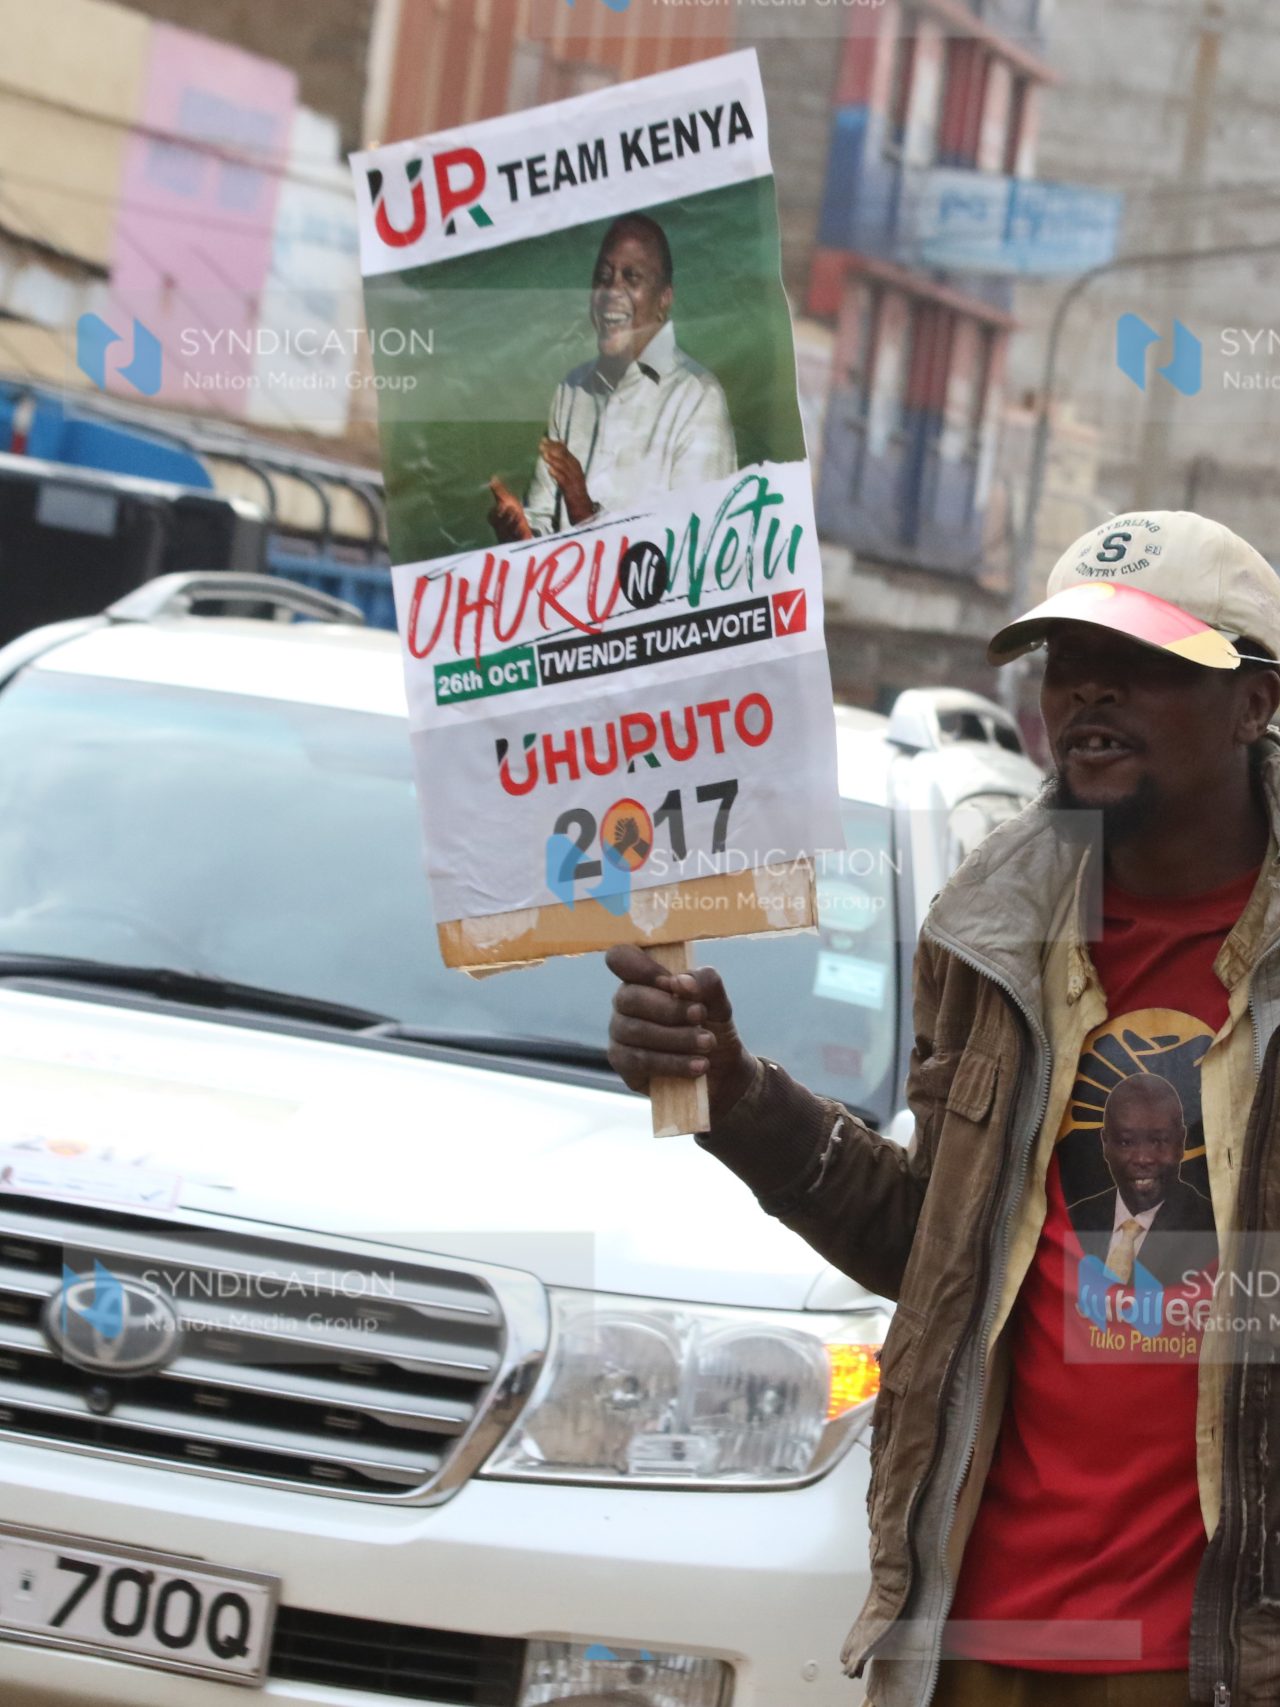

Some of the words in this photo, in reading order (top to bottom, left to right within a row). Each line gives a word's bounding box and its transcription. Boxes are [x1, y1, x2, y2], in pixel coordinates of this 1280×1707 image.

[366, 146, 495, 248] UR
[496, 137, 609, 203] TEAM
[619, 100, 754, 172] KENYA
[409, 535, 630, 671] UHURU
[625, 546, 661, 600] Ni
[665, 474, 803, 607] Wetu
[1096, 532, 1132, 562] S
[1120, 558, 1150, 574] CLUB
[540, 638, 637, 678] TWENDE
[642, 607, 766, 657] TUKA-VOTE
[437, 664, 483, 696] 26th
[487, 660, 532, 687] OCT
[496, 692, 773, 796] UHURUTO
[1075, 1284, 1213, 1327] Jubilee
[1089, 1326, 1126, 1352] Tuko
[1130, 1330, 1197, 1358] Pamoja
[48, 1556, 251, 1659] 700Q
